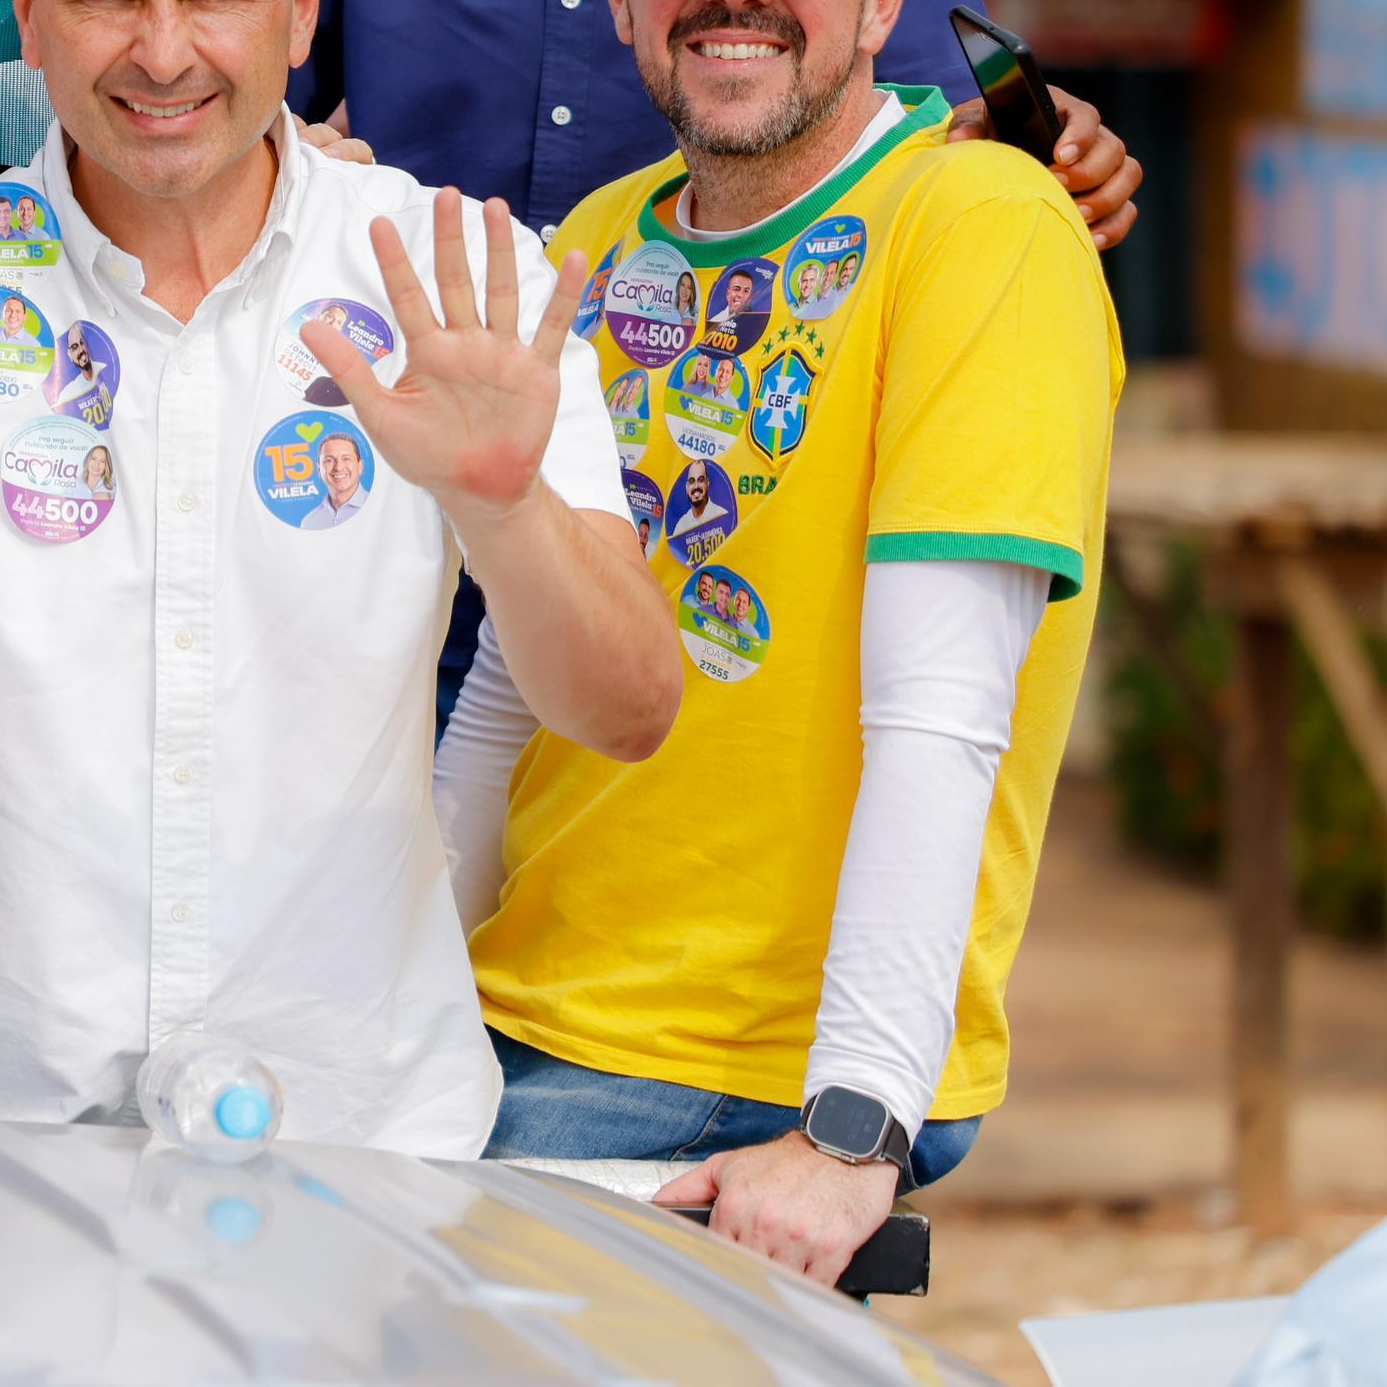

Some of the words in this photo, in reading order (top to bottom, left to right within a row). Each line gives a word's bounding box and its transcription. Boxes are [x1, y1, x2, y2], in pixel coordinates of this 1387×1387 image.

[27, 244, 43, 259] 15
[805, 239, 850, 254] VILELA
[587, 267, 613, 303] 15
[347, 320, 384, 346] Leandro
[349, 330, 375, 351] Vilela
[619, 321, 685, 350] 44500
[19, 349, 37, 365] 15
[289, 343, 320, 366] JOHNNY
[277, 353, 313, 381] 11145
[768, 393, 792, 408] CBF
[688, 400, 721, 423] VILELA
[720, 409, 734, 426] 15
[624, 421, 636, 437] 15
[38, 435, 51, 443] Pra
[52, 437, 75, 445] seguir
[677, 433, 716, 456] 44180
[265, 442, 315, 483] 15
[53, 480, 78, 489] Rosa
[267, 484, 320, 500] VILELA
[624, 487, 657, 503] Leandro
[737, 474, 778, 495] BRA
[11, 492, 99, 525] 44500
[629, 496, 652, 510] Vilela
[702, 619, 739, 648] VILELA
[738, 635, 751, 652] 15
[701, 643, 727, 661] JOAS
[699, 659, 730, 681] 27555
